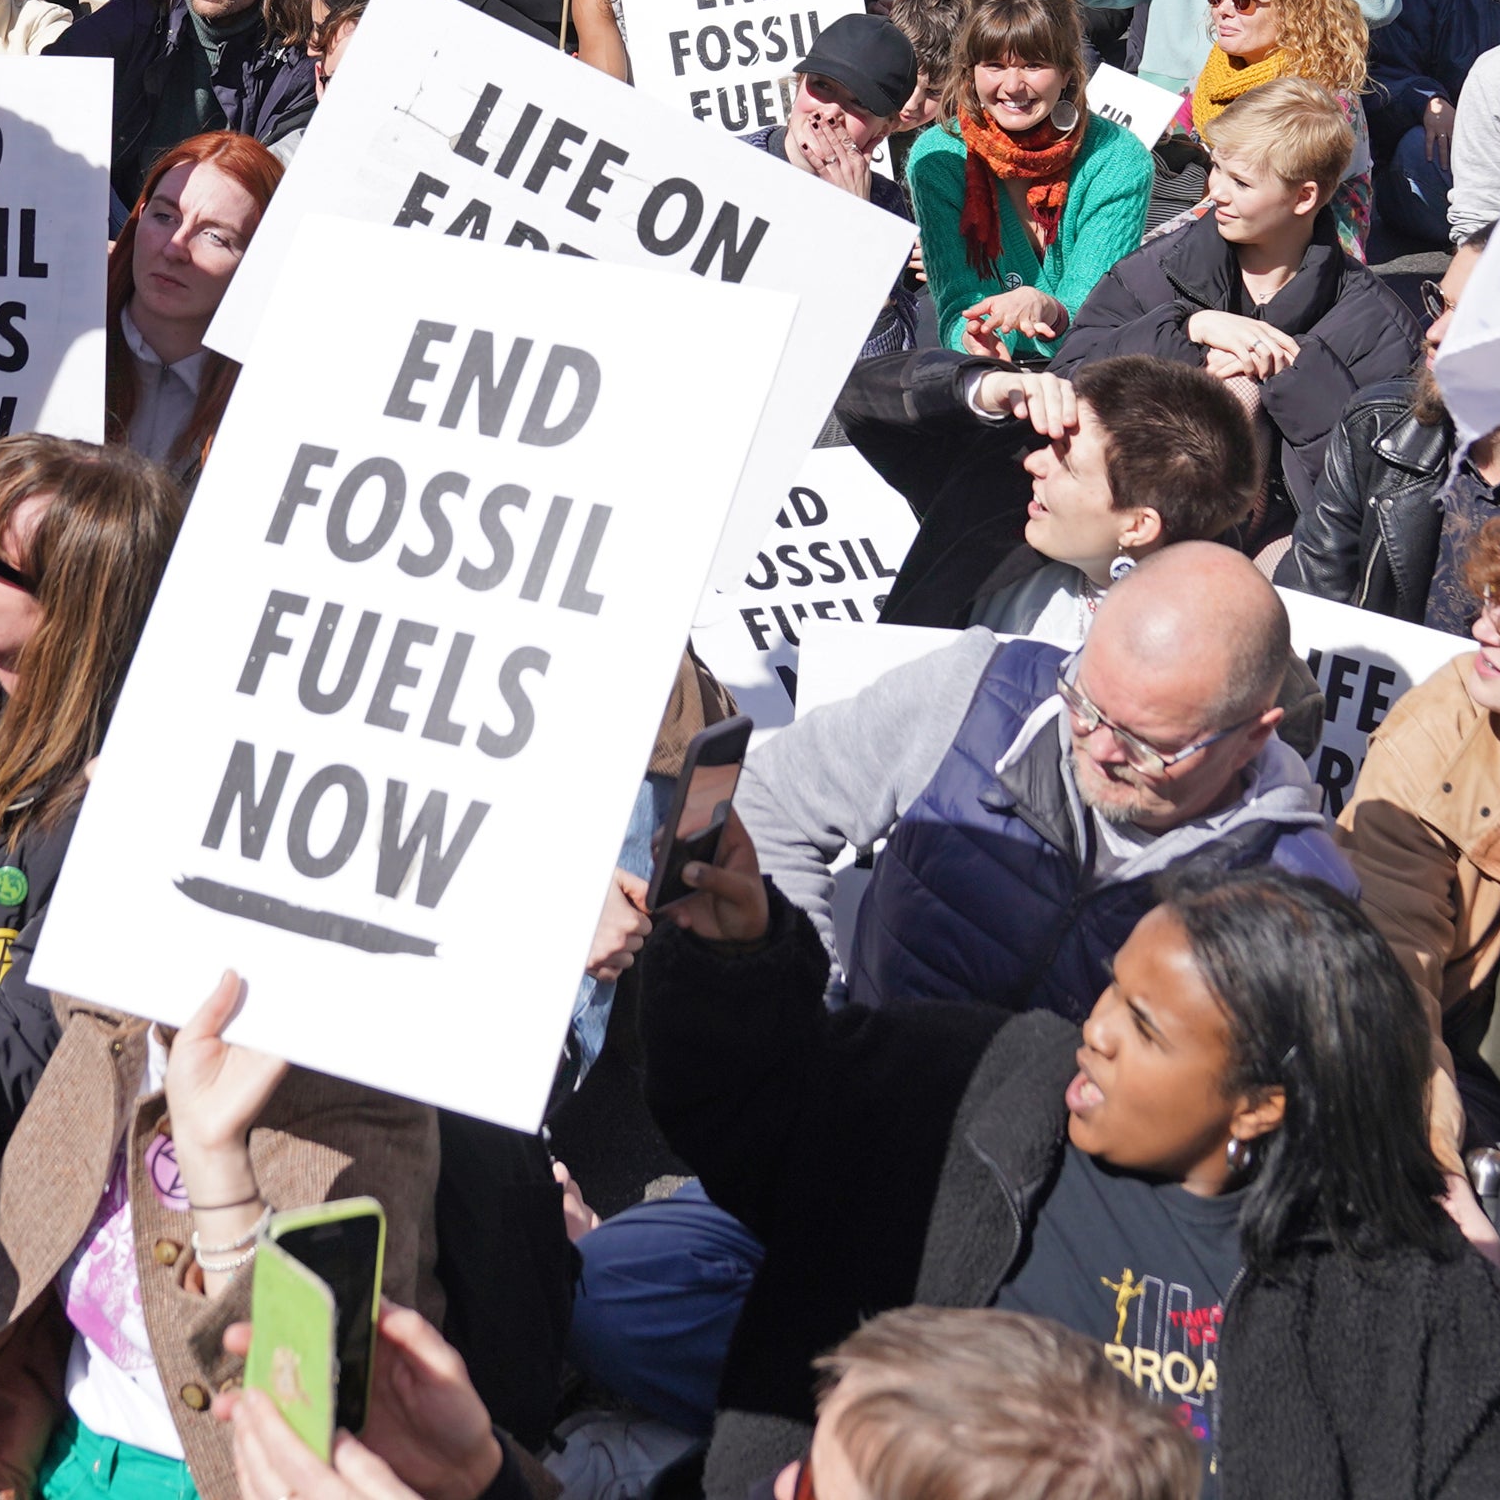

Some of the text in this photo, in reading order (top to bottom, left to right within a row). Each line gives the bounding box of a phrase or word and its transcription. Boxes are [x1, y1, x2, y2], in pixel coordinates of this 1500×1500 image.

[450, 80, 630, 226] LIFE
[636, 175, 771, 285] ON
[383, 317, 603, 449] END
[263, 442, 614, 617] FOSSIL
[235, 588, 554, 762] FUELS
[198, 738, 493, 911] NOW
